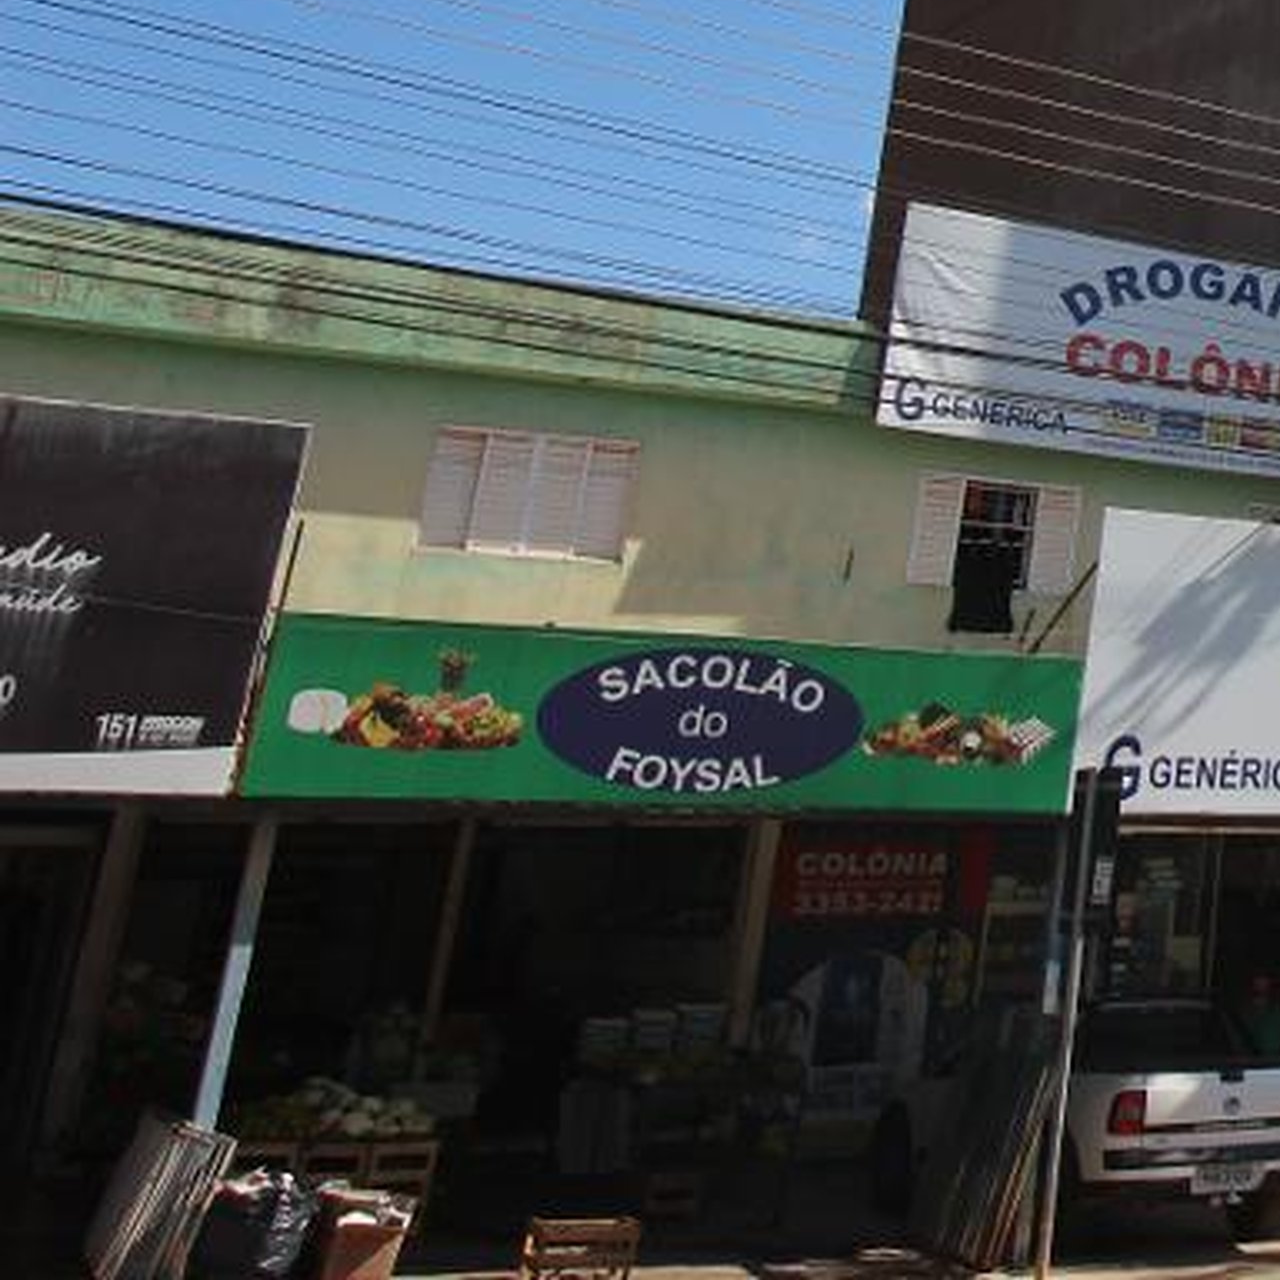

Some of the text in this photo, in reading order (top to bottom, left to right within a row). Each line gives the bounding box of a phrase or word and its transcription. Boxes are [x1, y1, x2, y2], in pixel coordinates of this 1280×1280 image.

[599, 655, 825, 712] SACOLÃO
[678, 704, 728, 737] do
[605, 746, 781, 792] FOYSAL
